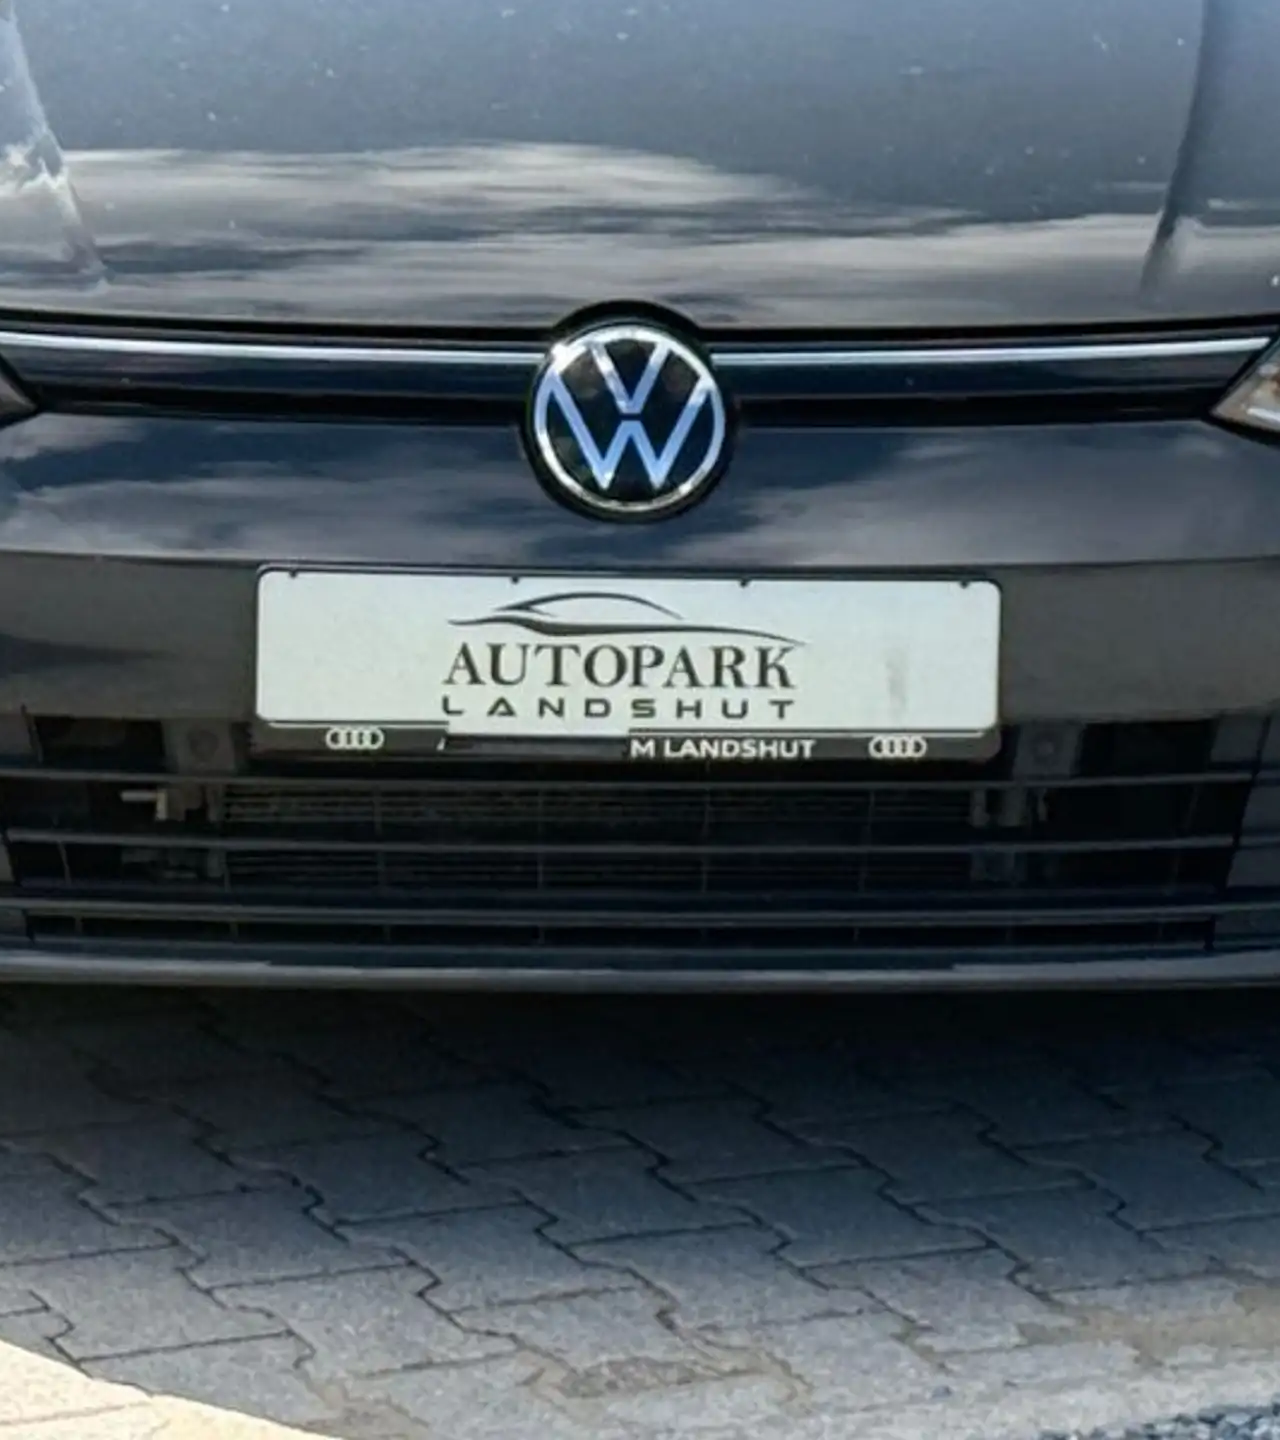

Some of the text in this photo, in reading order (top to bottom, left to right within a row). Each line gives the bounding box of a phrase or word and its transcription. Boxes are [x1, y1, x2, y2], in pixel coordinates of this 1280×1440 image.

[442, 642, 796, 689] AUTOPARK
[441, 695, 795, 720] LANDSHUT
[663, 739, 815, 759] LANDSHUT
